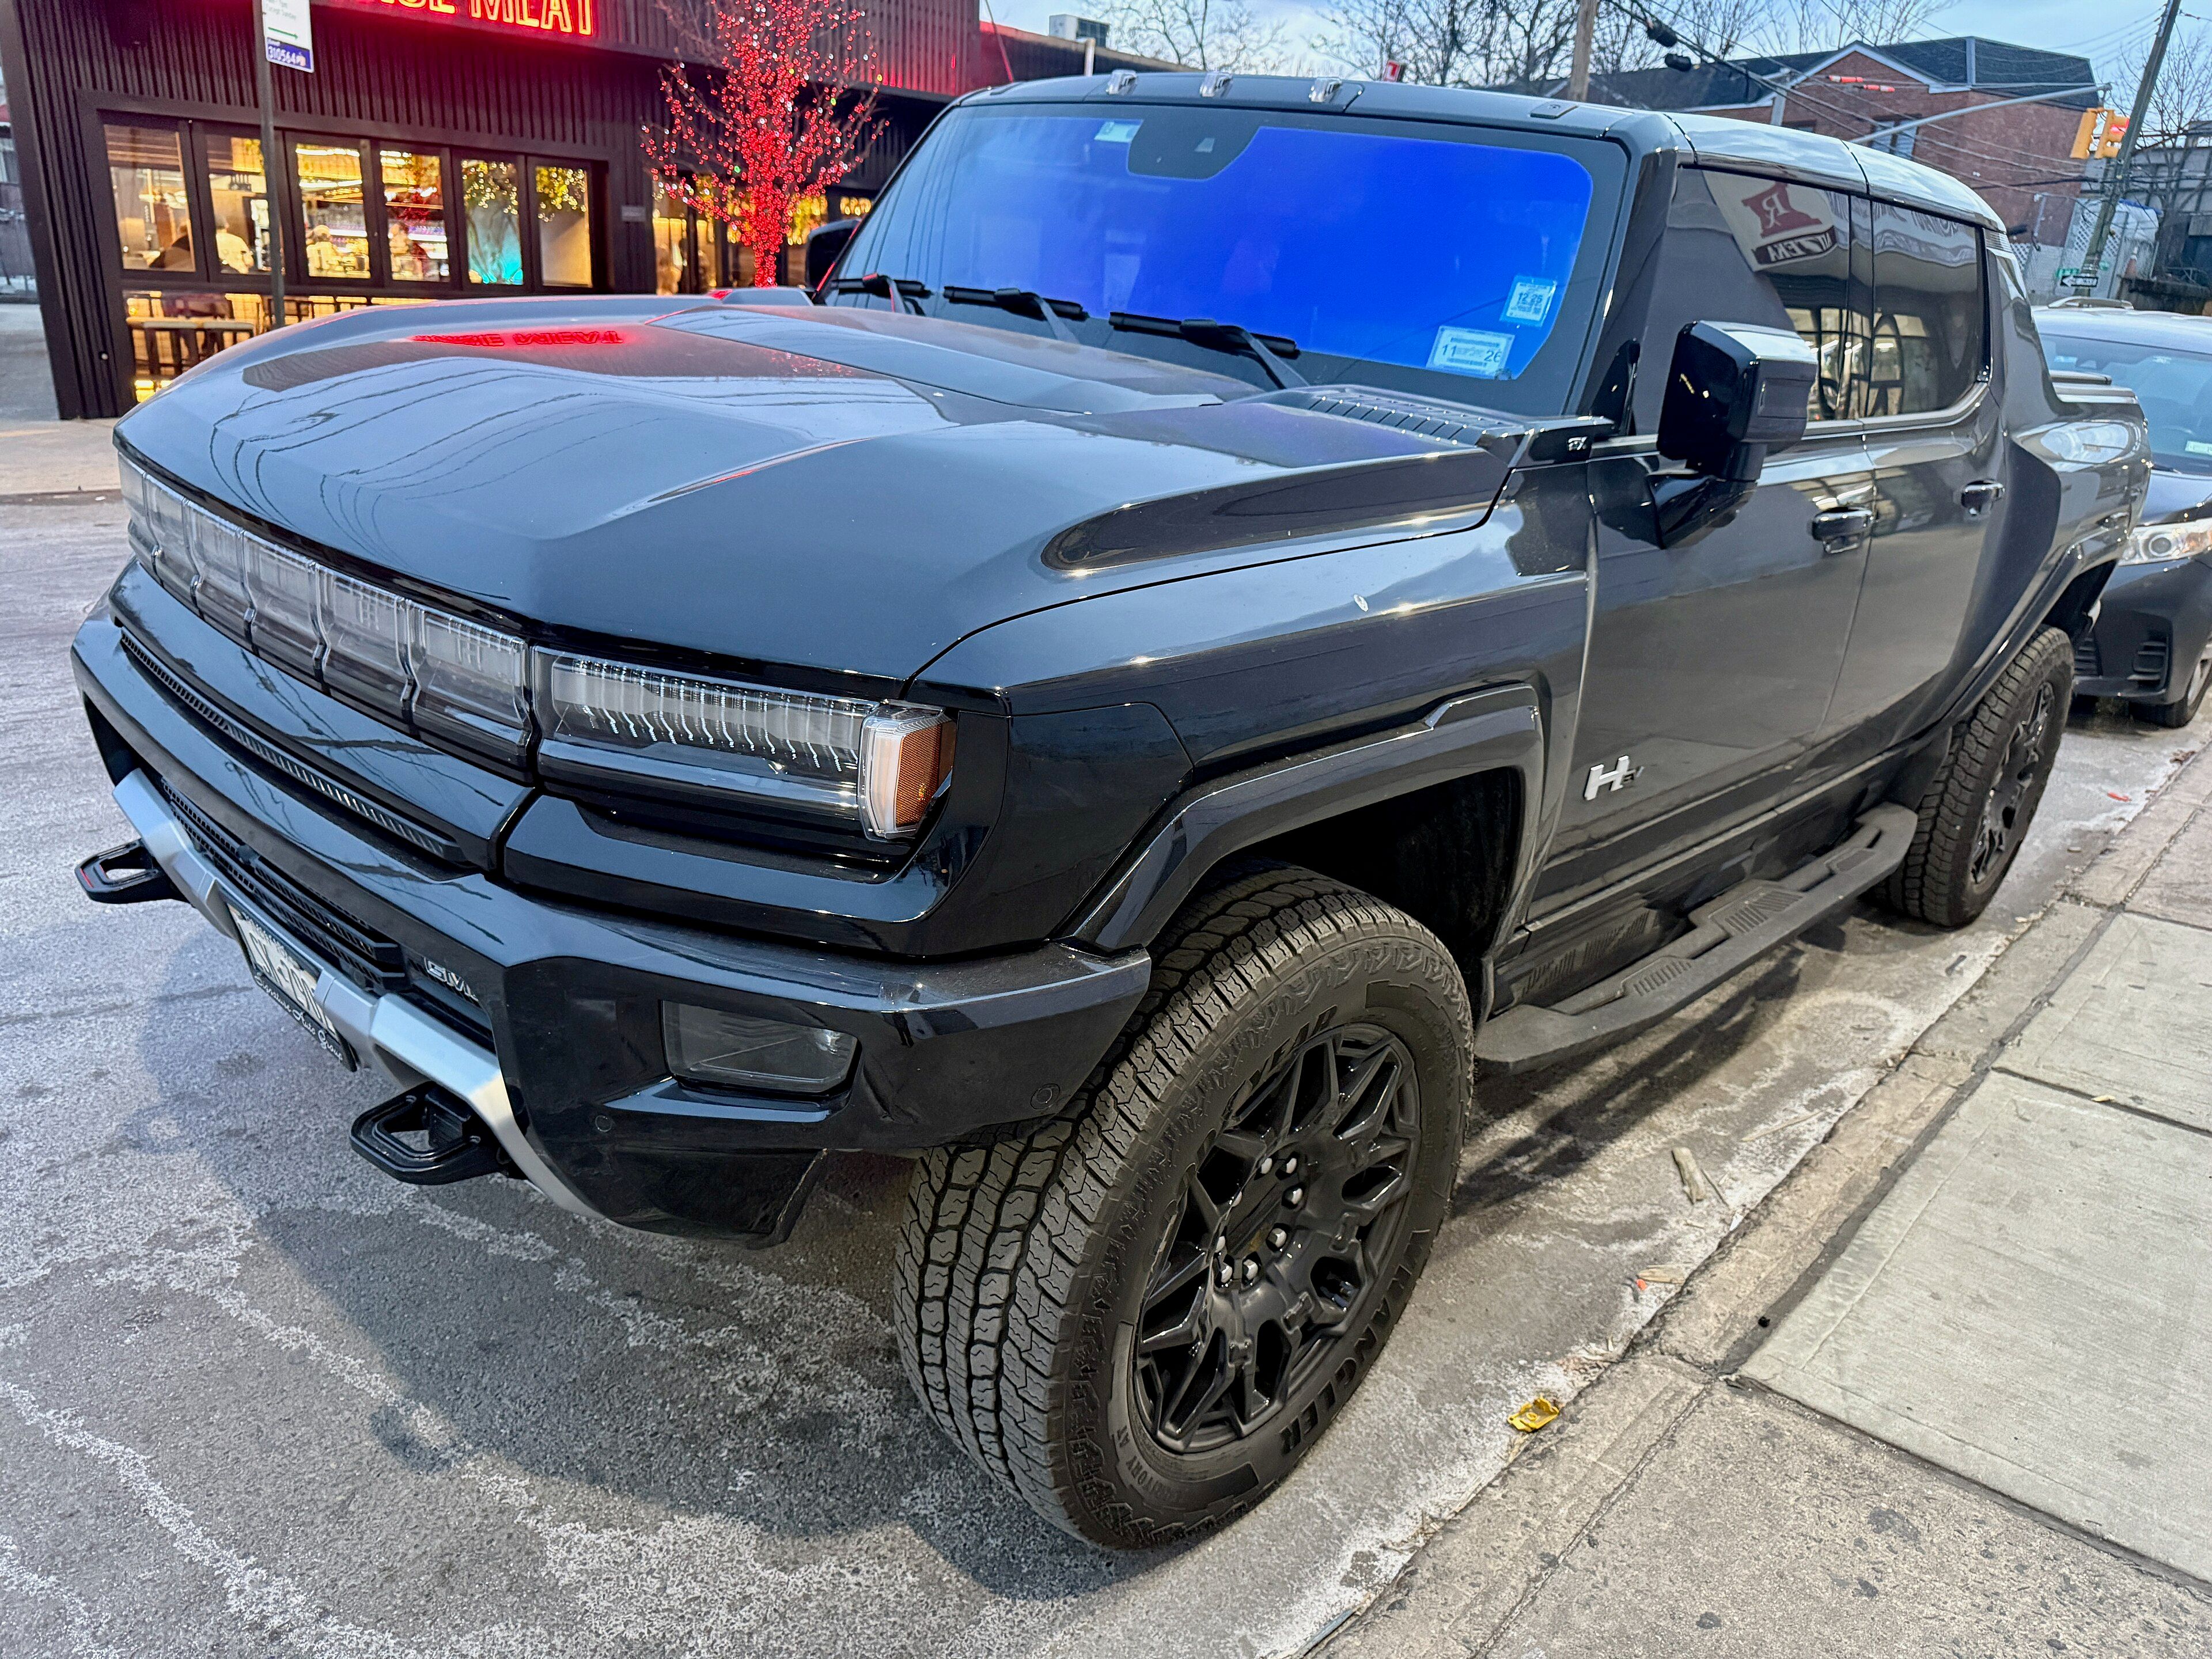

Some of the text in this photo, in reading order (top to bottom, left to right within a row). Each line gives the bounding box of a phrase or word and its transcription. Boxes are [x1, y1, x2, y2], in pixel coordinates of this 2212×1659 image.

[292, 1008, 316, 1035] Auto
[318, 1029, 344, 1061] Group
[1279, 1229, 1431, 1455] WRANGLER
